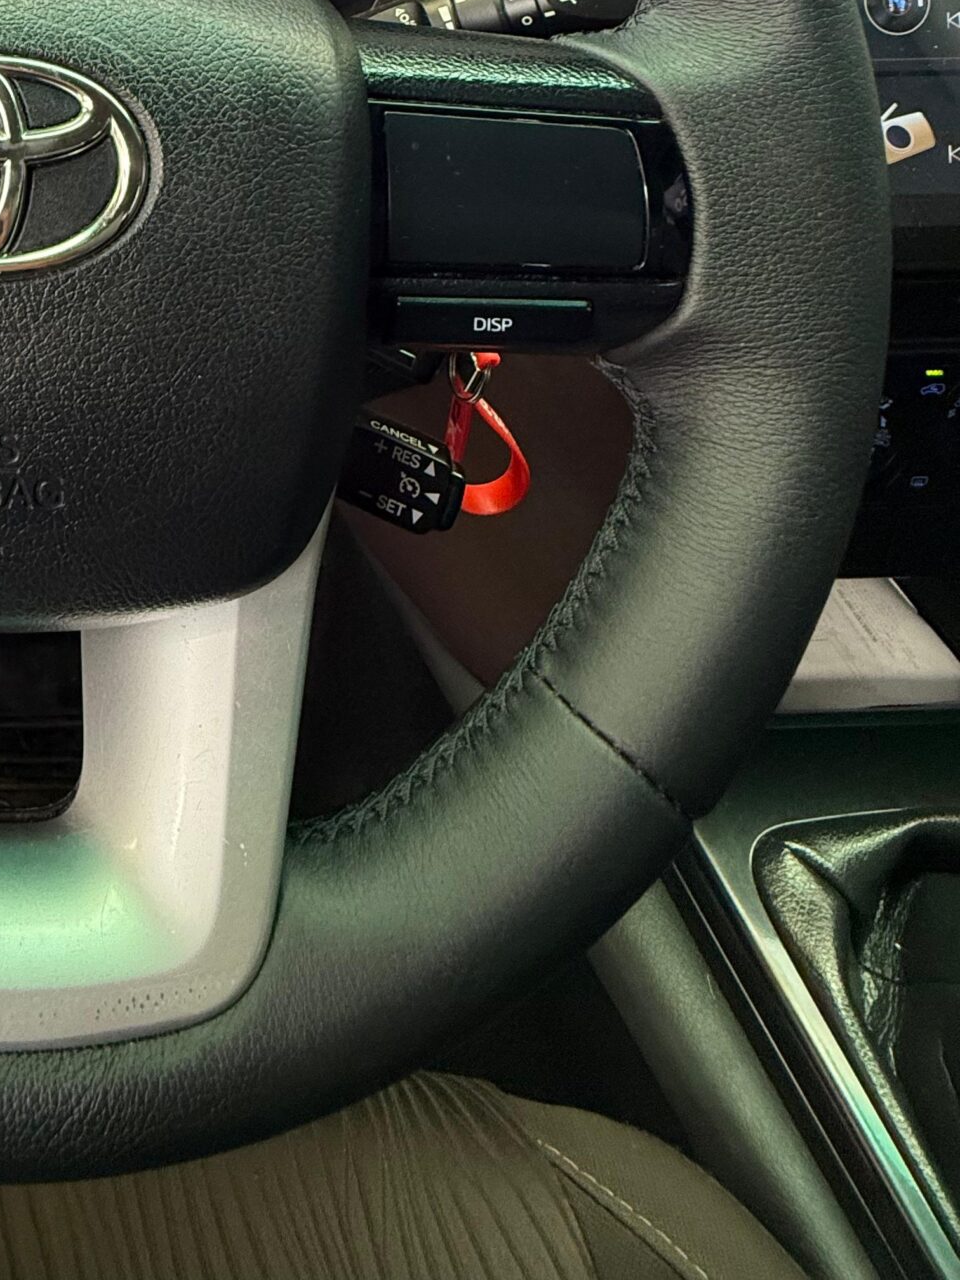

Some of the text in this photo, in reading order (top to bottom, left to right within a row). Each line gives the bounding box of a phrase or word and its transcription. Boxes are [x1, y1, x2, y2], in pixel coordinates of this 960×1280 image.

[473, 316, 513, 332] DISP
[370, 420, 427, 450] CANCEL
[392, 446, 421, 469] RES
[376, 495, 407, 517] SET
